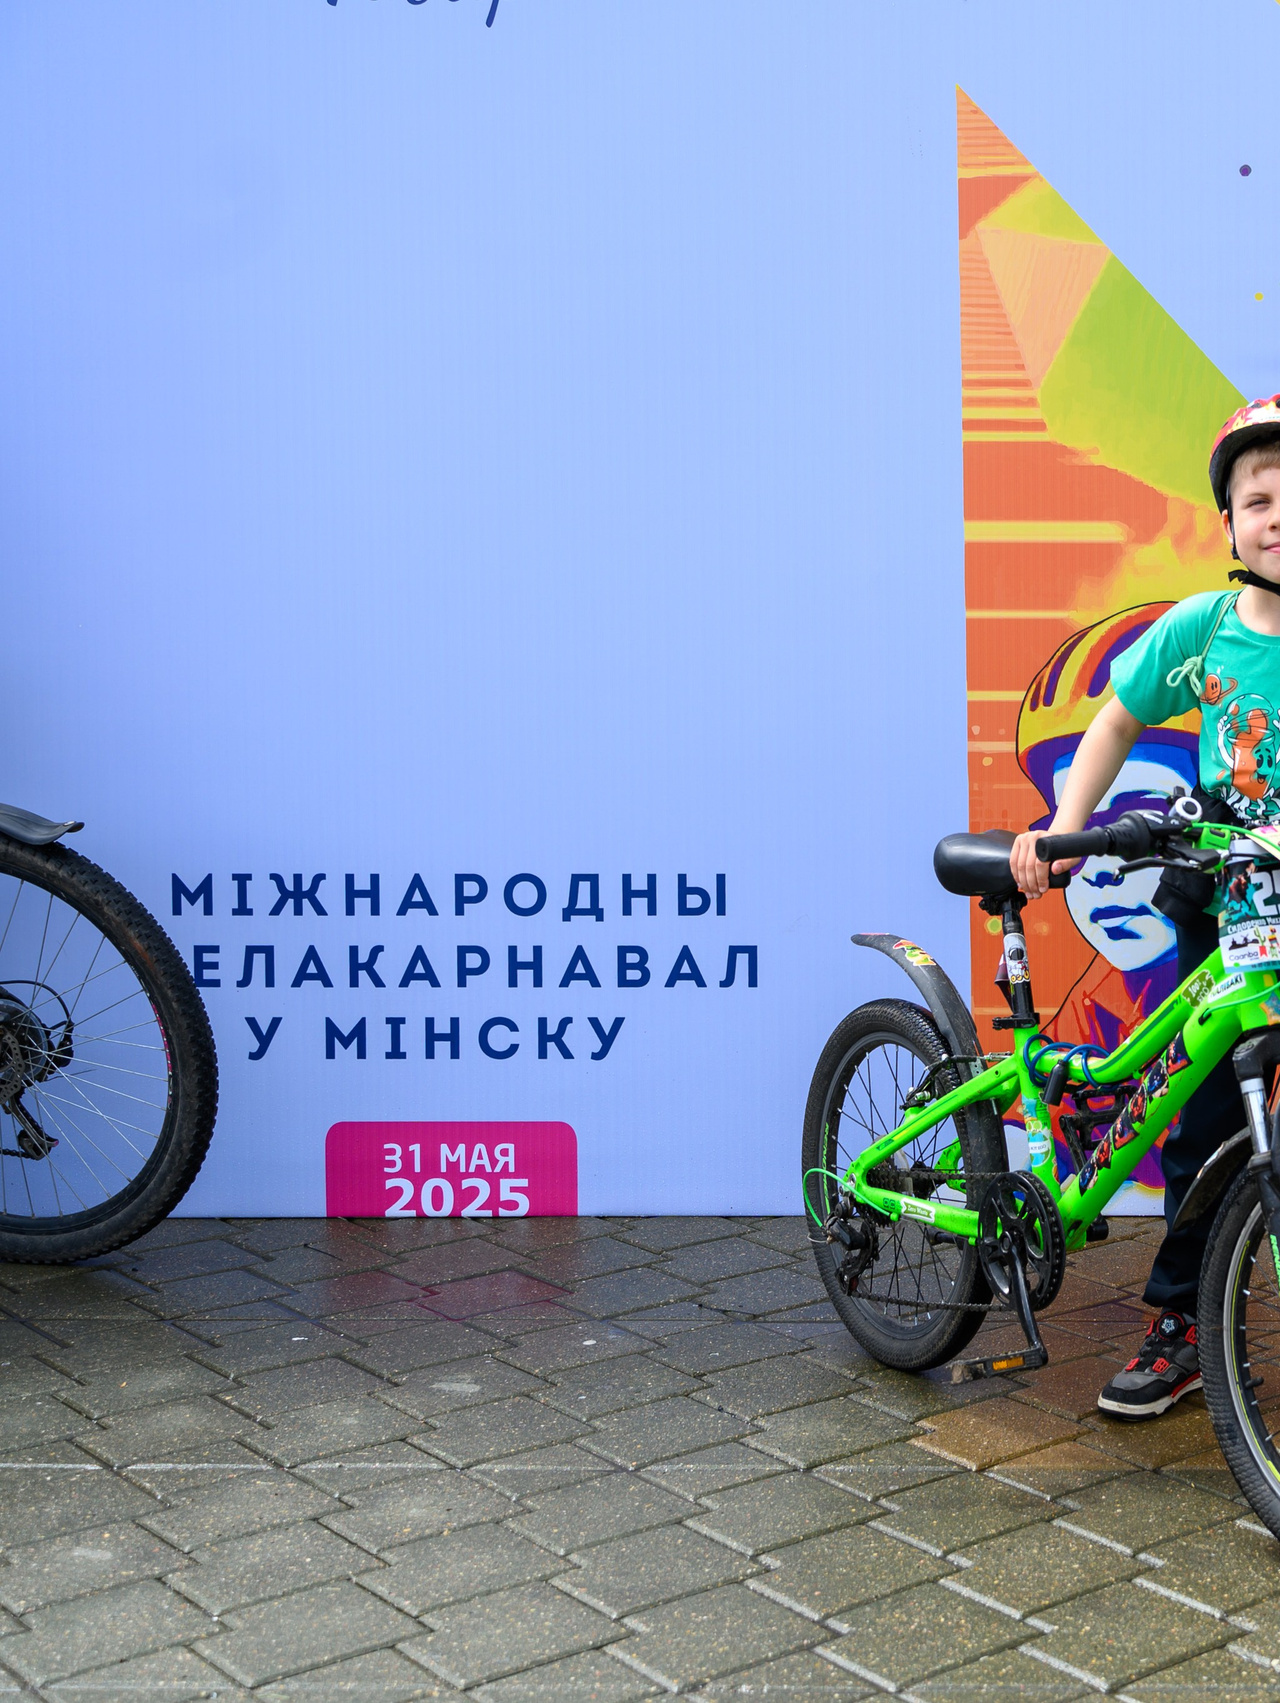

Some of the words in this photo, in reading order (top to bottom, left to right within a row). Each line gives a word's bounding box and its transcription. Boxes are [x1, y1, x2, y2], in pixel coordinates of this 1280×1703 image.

[171, 873, 727, 922] МІЖНАРОДНЫ
[193, 945, 760, 988] ЕЛАКАРНАВАЛ
[247, 1016, 283, 1061] У
[325, 1016, 626, 1061] МІНСКУ
[383, 1143, 421, 1174] 31
[440, 1143, 517, 1173] МАЯ
[383, 1178, 530, 1217] 2025
